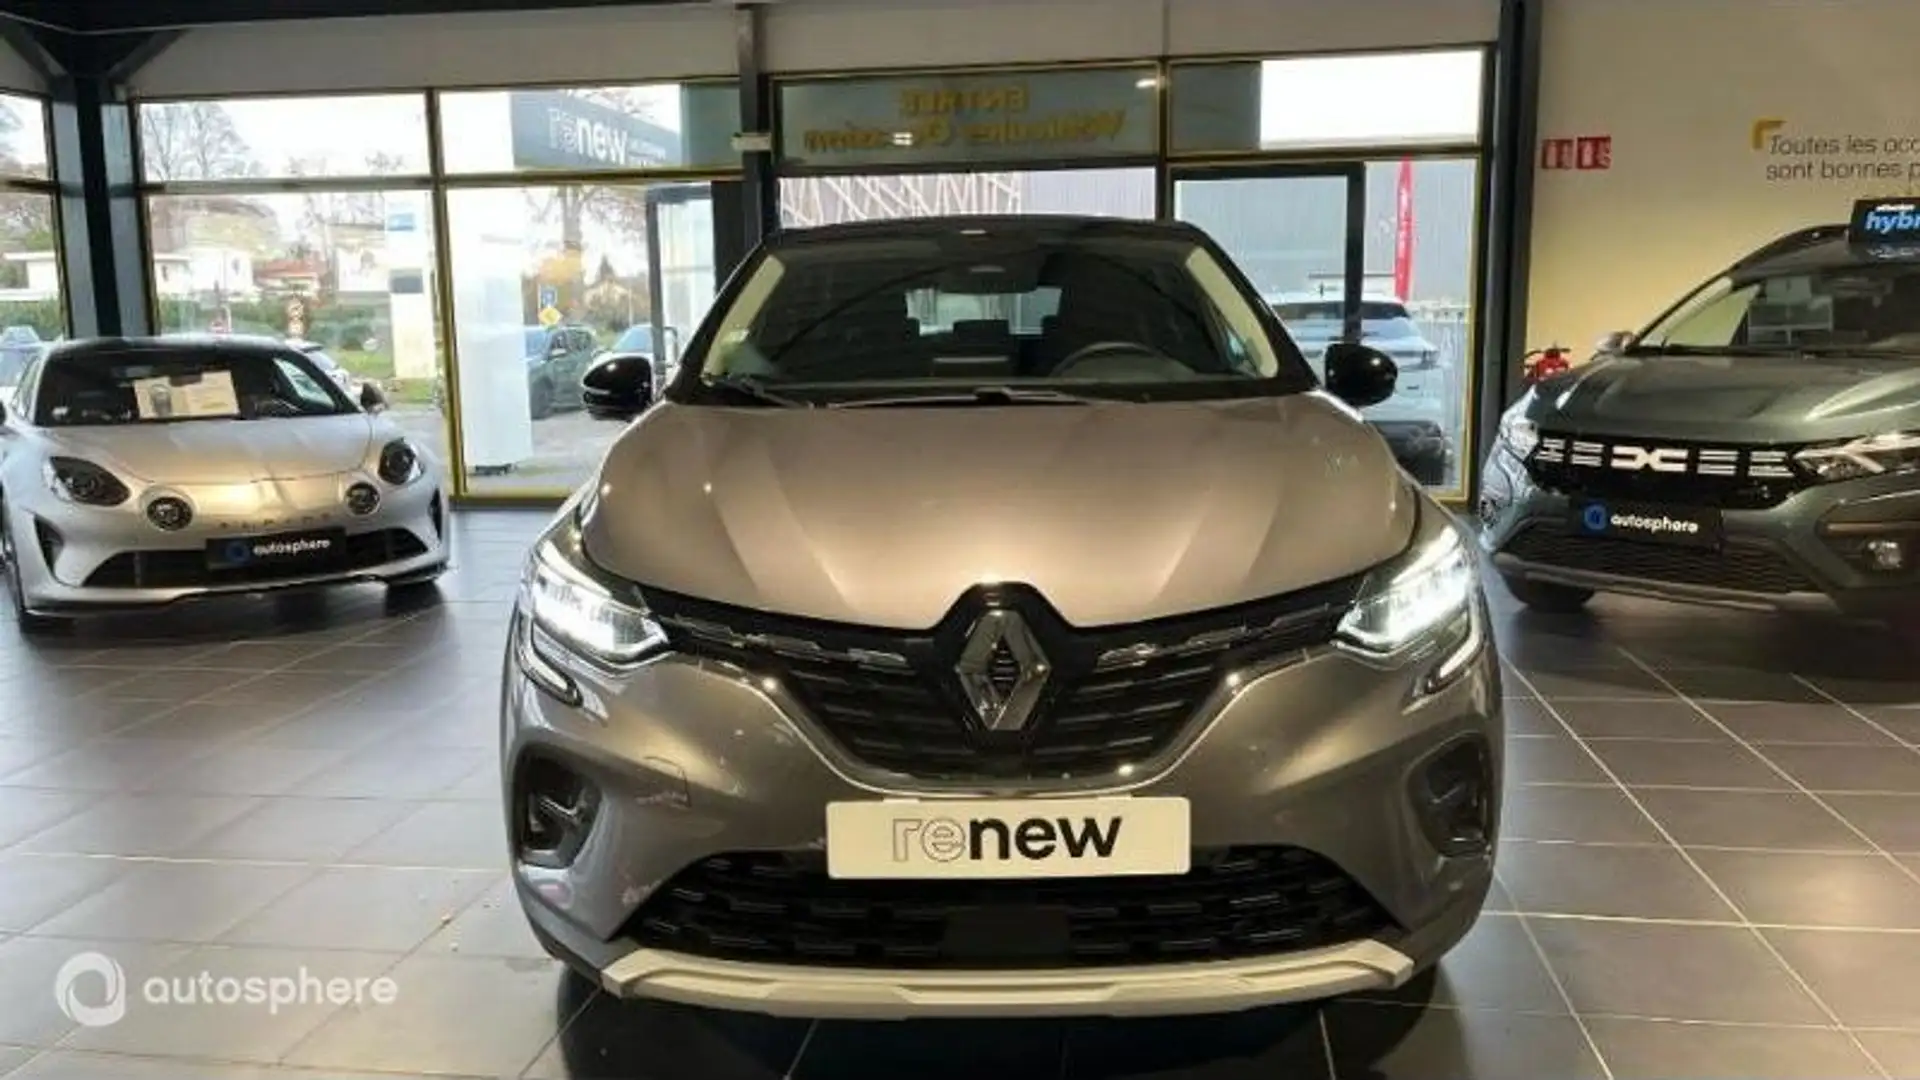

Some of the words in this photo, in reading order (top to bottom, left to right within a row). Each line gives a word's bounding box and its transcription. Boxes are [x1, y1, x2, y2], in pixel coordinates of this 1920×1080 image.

[1770, 134, 1840, 155] Toutes
[1849, 134, 1877, 153] les
[1766, 162, 1814, 180] sont
[1822, 160, 1902, 179] bonnes
[1610, 512, 1699, 534] autosphere
[892, 815, 1122, 862] renew
